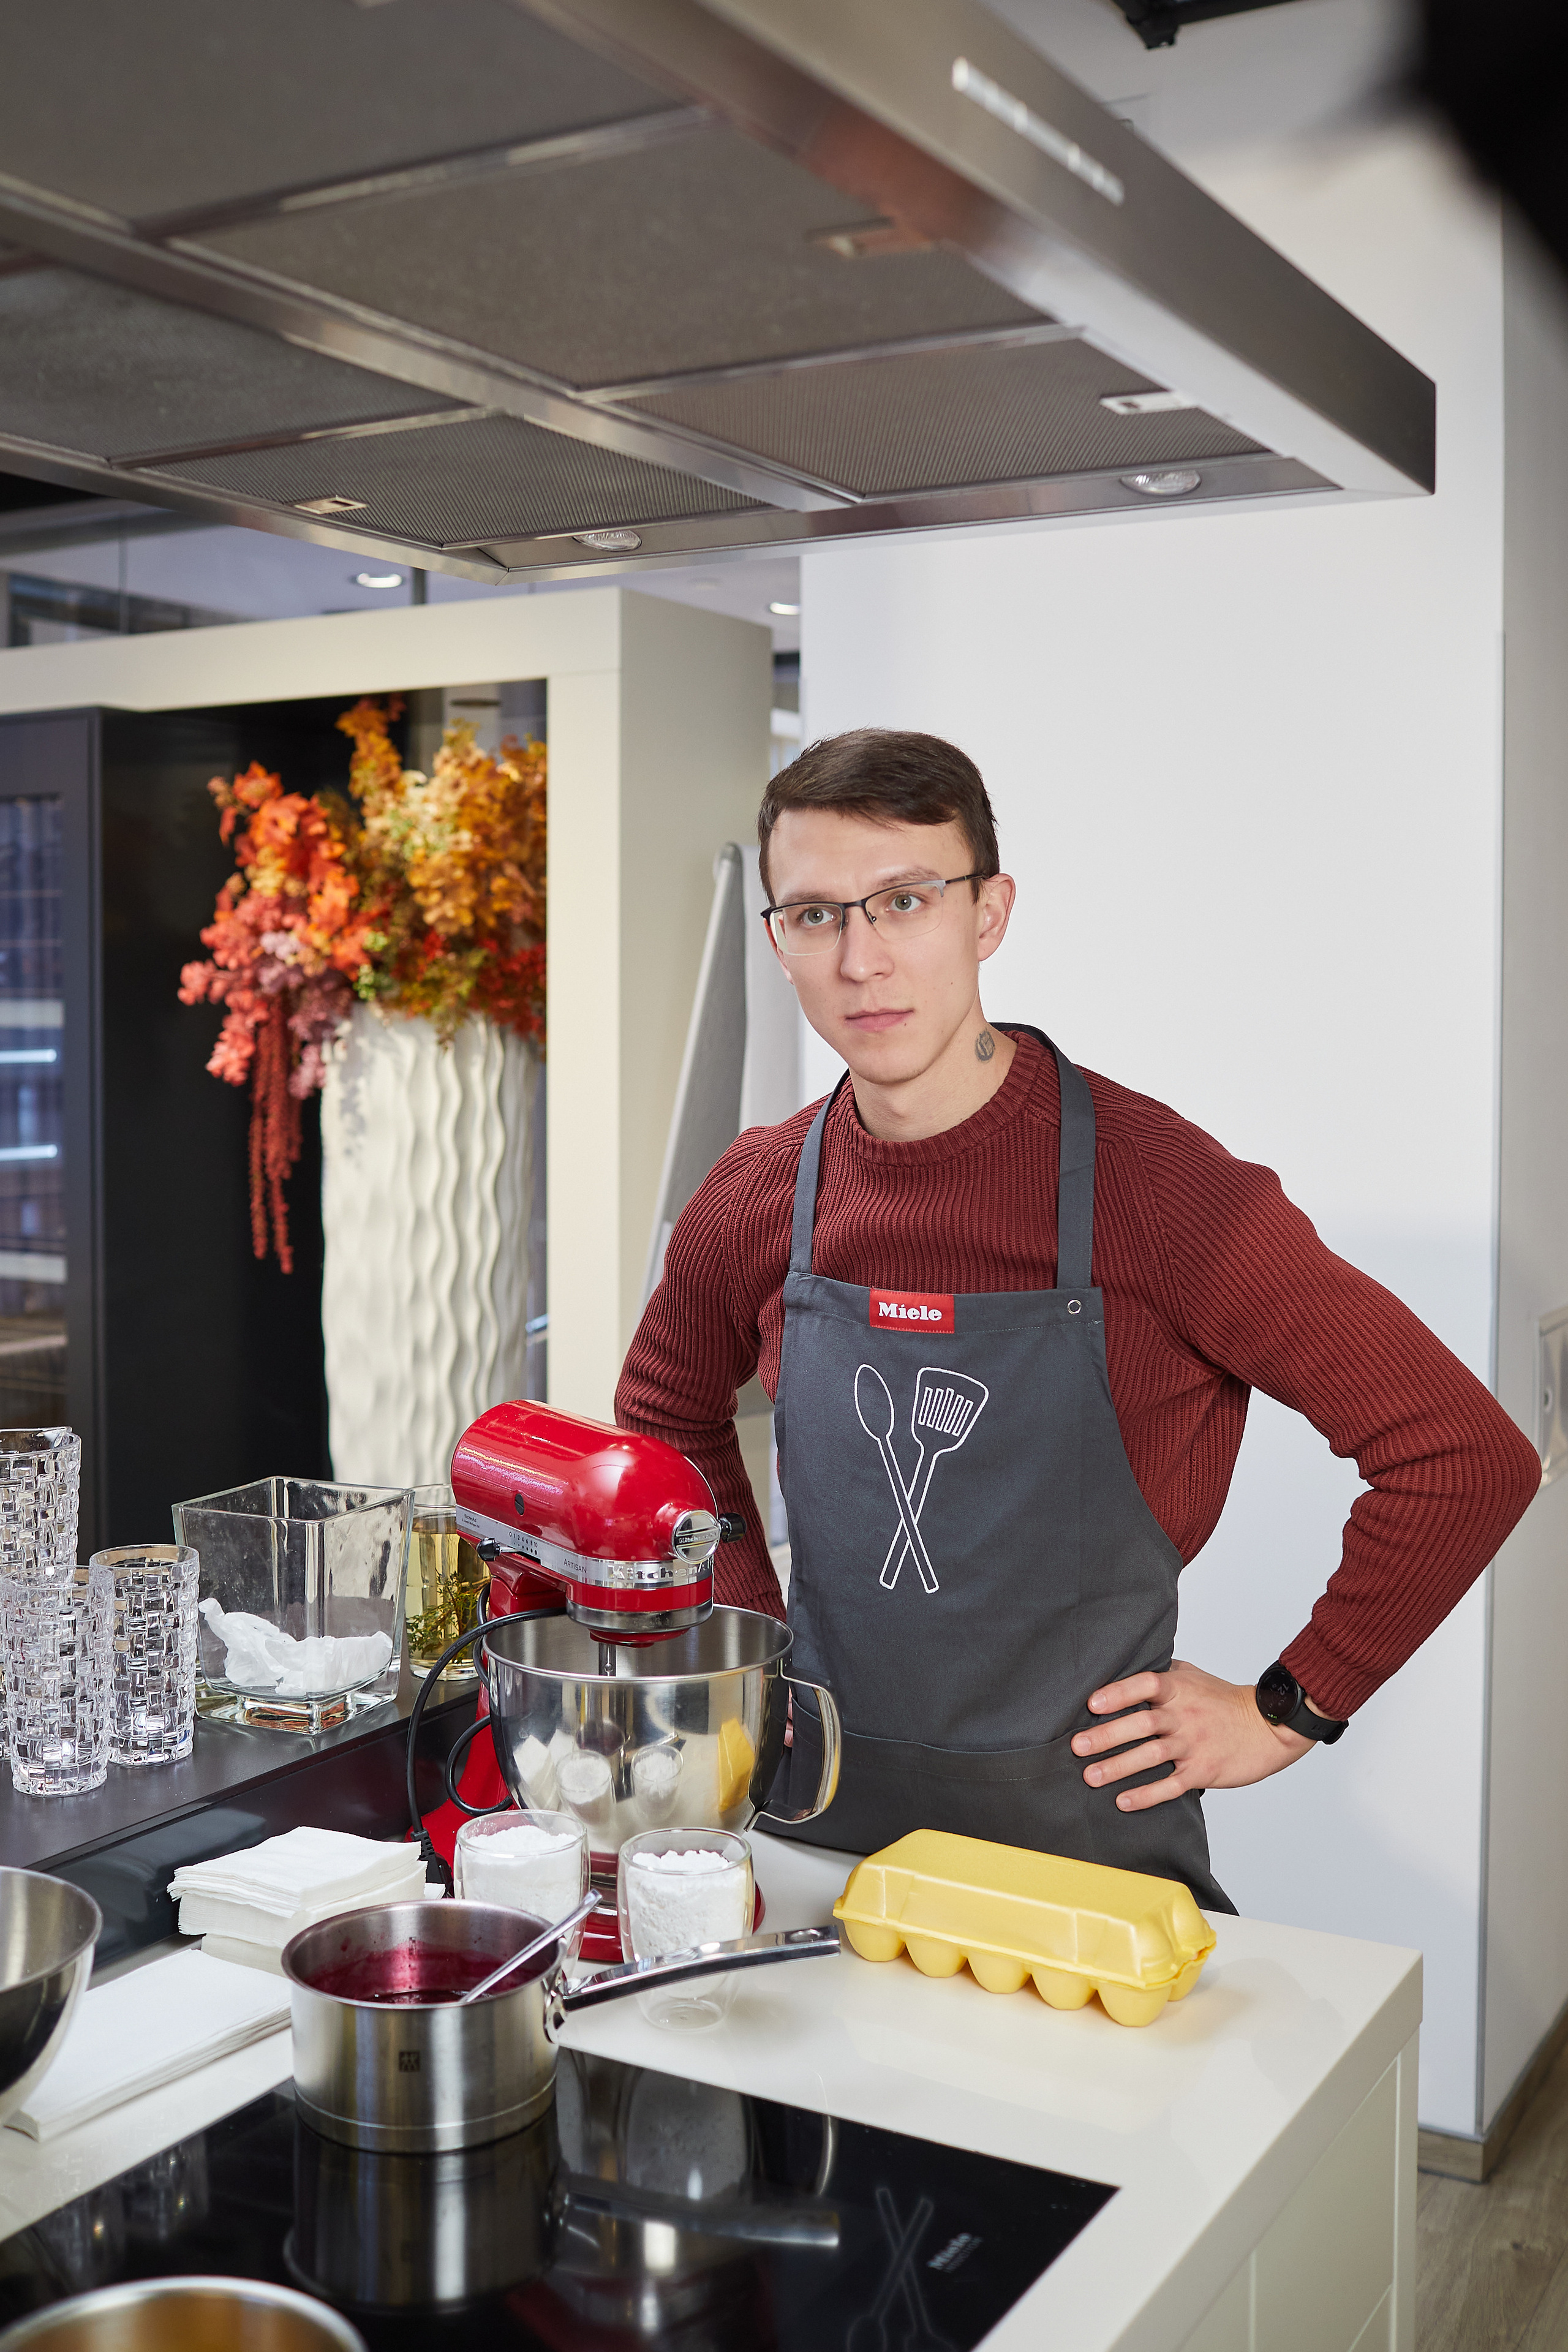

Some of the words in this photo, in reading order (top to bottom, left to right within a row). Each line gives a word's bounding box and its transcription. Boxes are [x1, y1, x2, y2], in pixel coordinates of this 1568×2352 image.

[878, 1302, 942, 1321] Miele
[563, 1558, 587, 1574] ARTISAN
[927, 2233, 971, 2270] Miele
